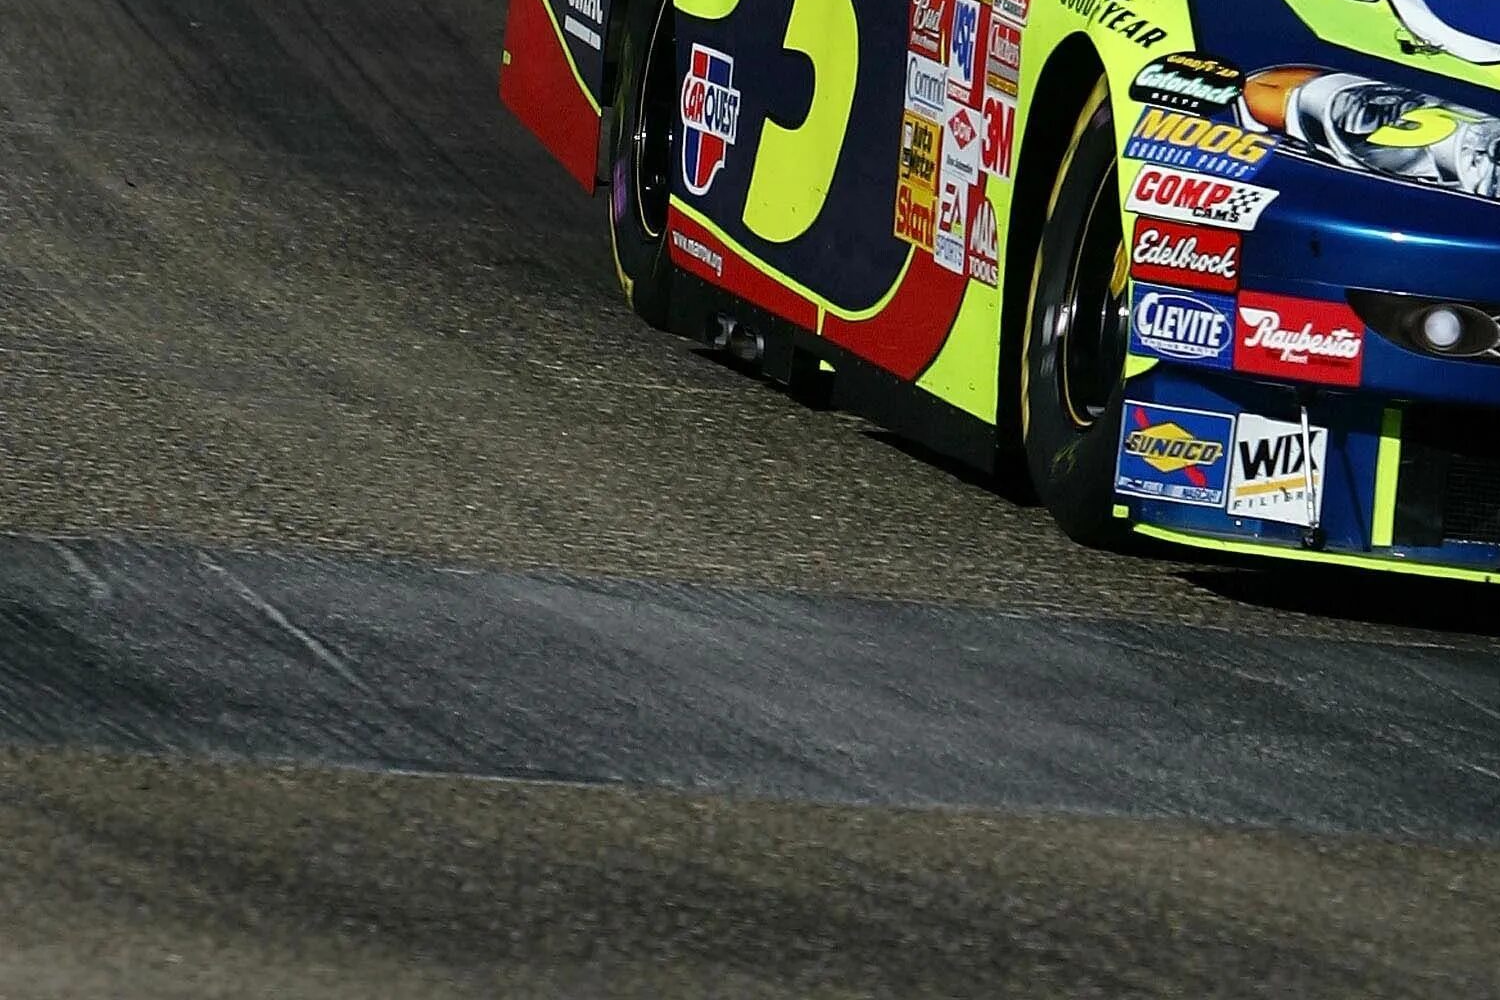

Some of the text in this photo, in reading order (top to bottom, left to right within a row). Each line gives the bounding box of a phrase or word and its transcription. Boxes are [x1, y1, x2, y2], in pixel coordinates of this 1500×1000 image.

[1134, 64, 1241, 102] Gatorback
[981, 97, 1015, 178] 3M
[1133, 108, 1278, 164] MOOG
[1128, 141, 1252, 179] CHASSIS PARTS
[1135, 171, 1234, 210] COMP
[1192, 206, 1240, 224] CAMS
[968, 254, 998, 286] TOOLS
[1133, 230, 1237, 279] Edelbrock
[1137, 291, 1224, 347] CLEVITE
[1239, 306, 1363, 360] Raybestos
[1128, 433, 1219, 463] SUNOCO
[1239, 430, 1322, 481] WIX
